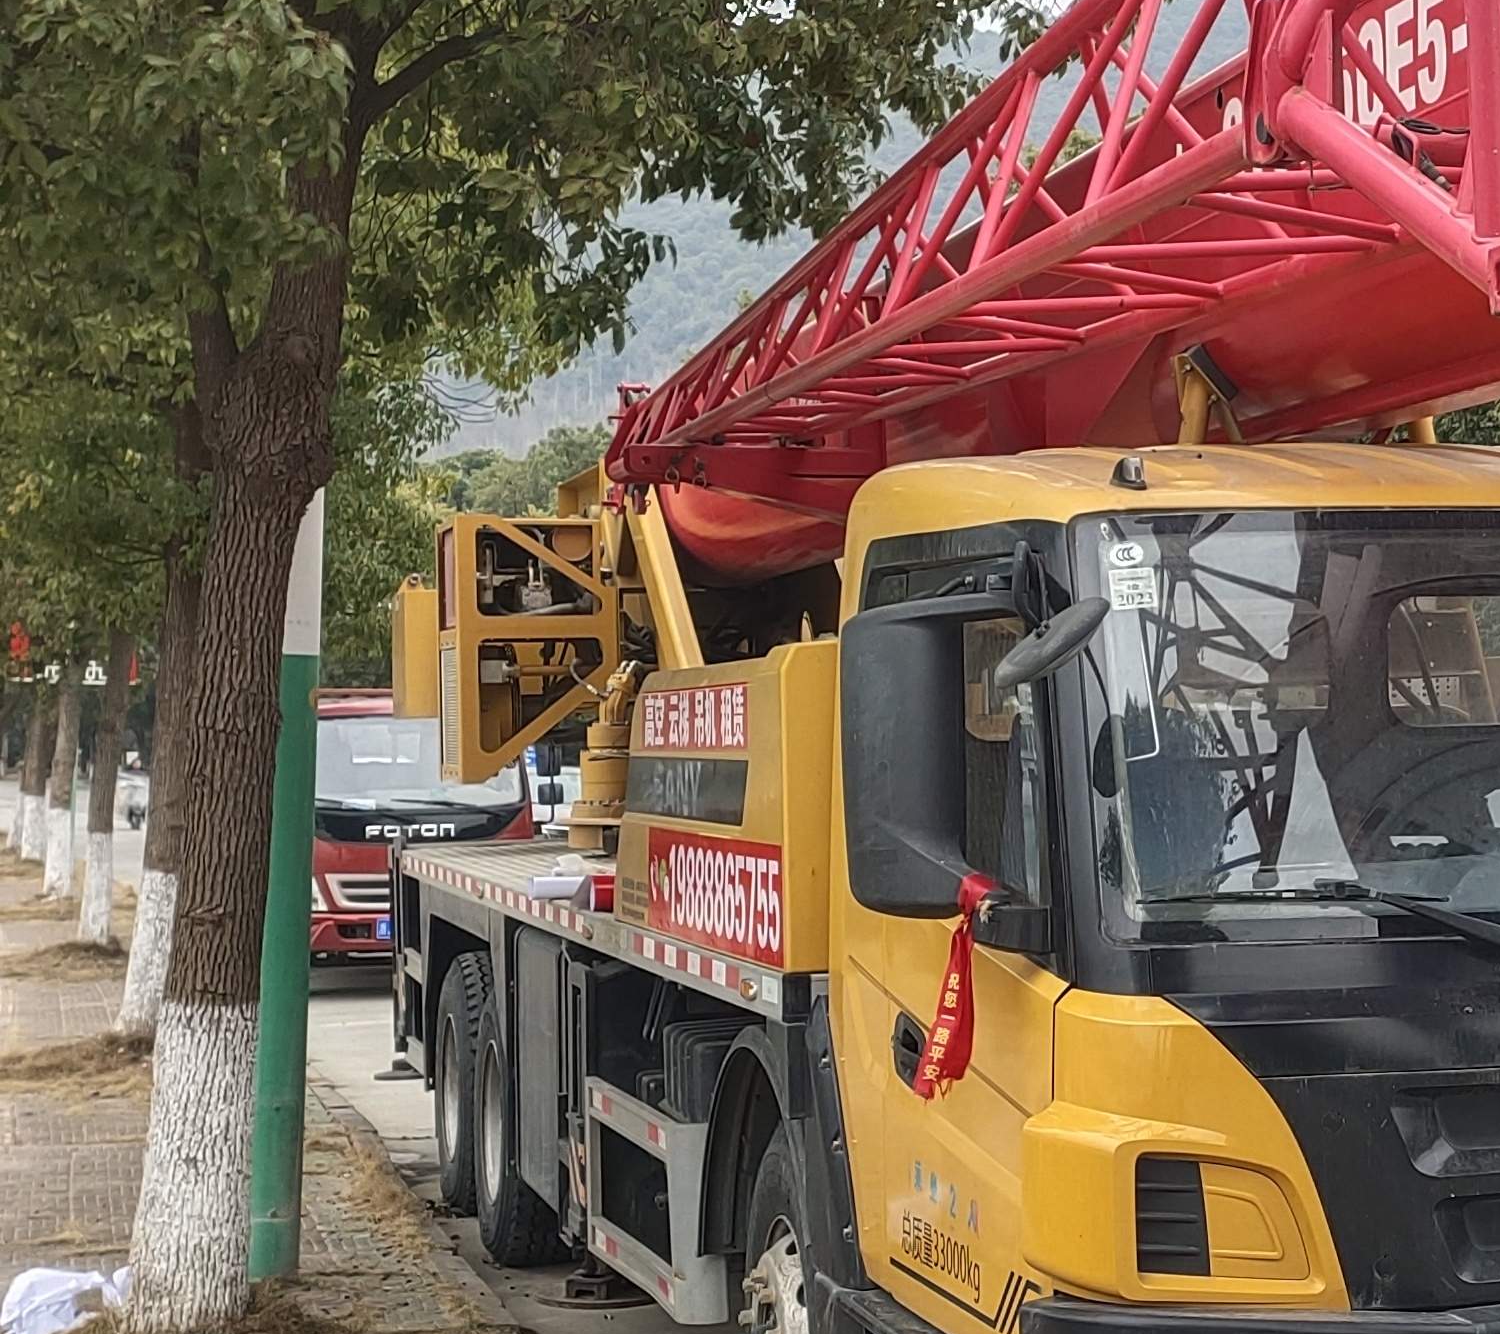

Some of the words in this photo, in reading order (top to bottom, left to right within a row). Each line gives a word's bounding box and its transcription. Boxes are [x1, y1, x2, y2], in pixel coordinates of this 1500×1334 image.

[1118, 592, 1153, 606] 2023
[365, 823, 455, 839] FOTON
[669, 843, 781, 953] 19888865755
[922, 973, 960, 1082] 祝您一路平安
